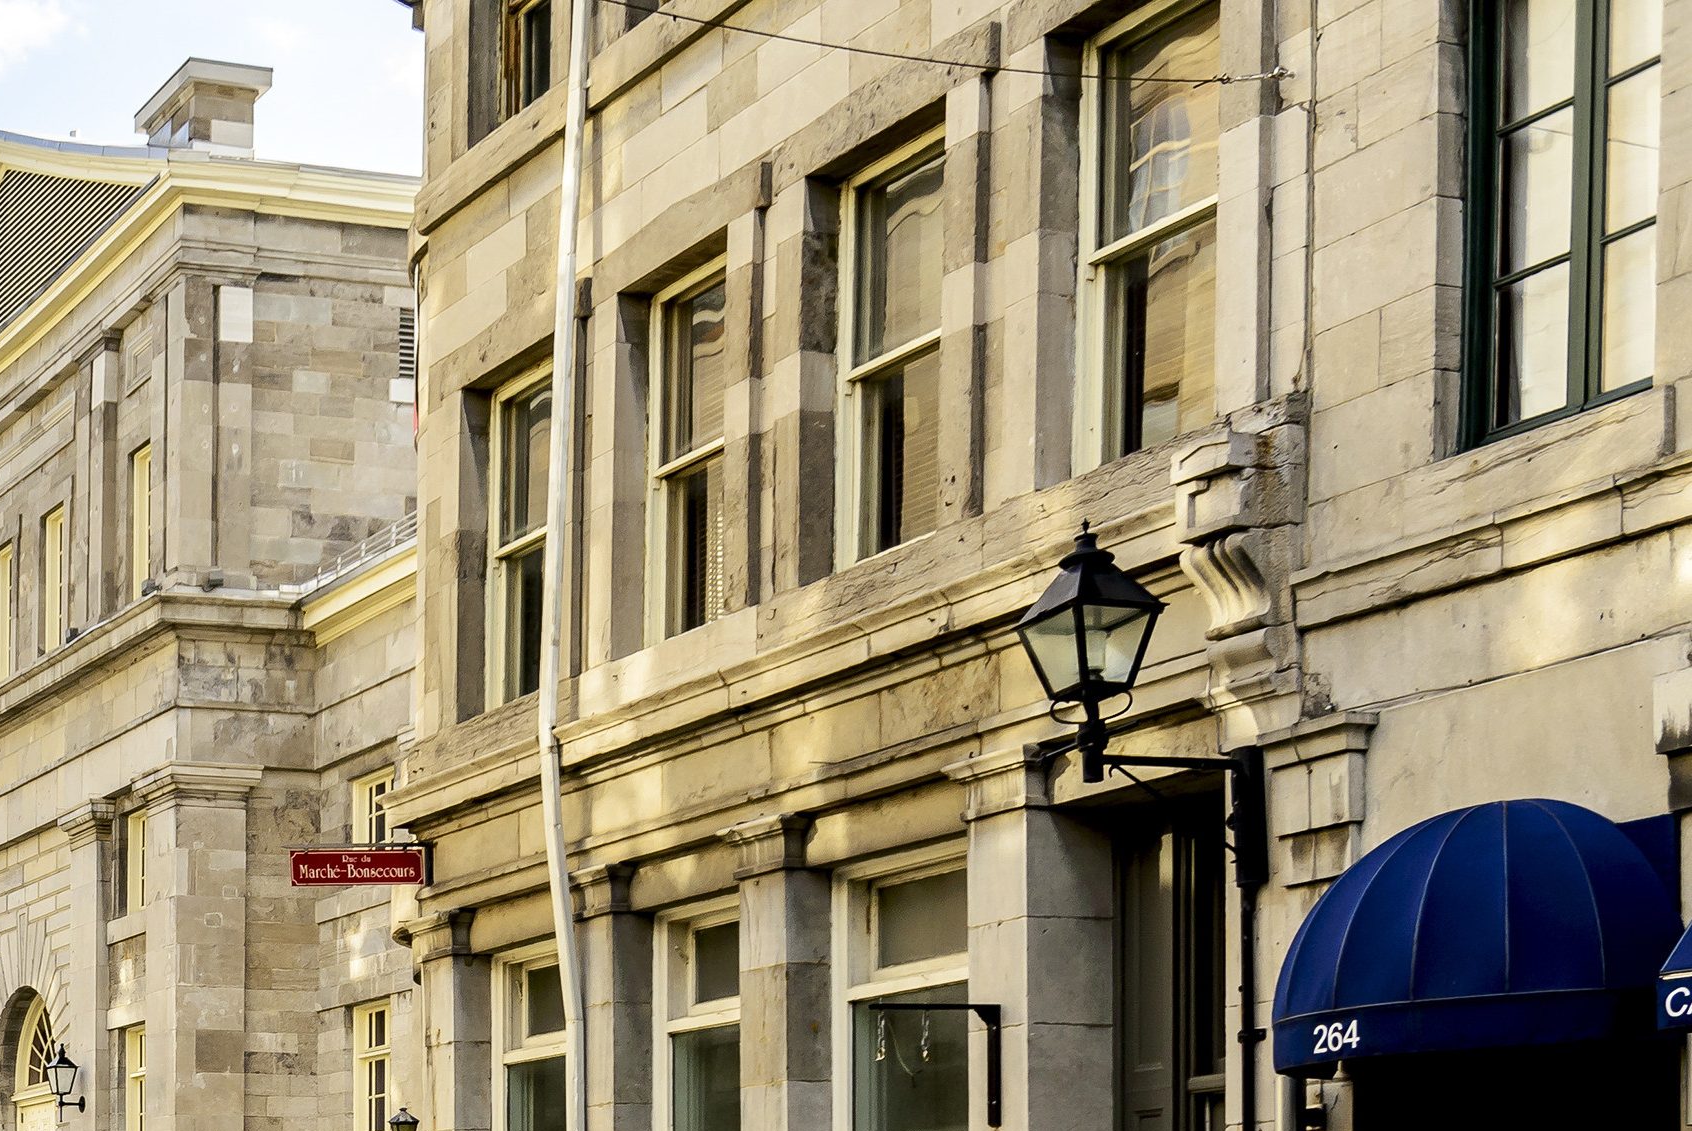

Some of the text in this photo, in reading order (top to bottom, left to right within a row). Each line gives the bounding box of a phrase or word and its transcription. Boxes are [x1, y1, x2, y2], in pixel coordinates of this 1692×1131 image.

[299, 863, 416, 879] Marché-Bonsecours
[342, 855, 371, 863] Rue du
[1665, 986, 1692, 1018] C
[1313, 1019, 1361, 1055] 264
